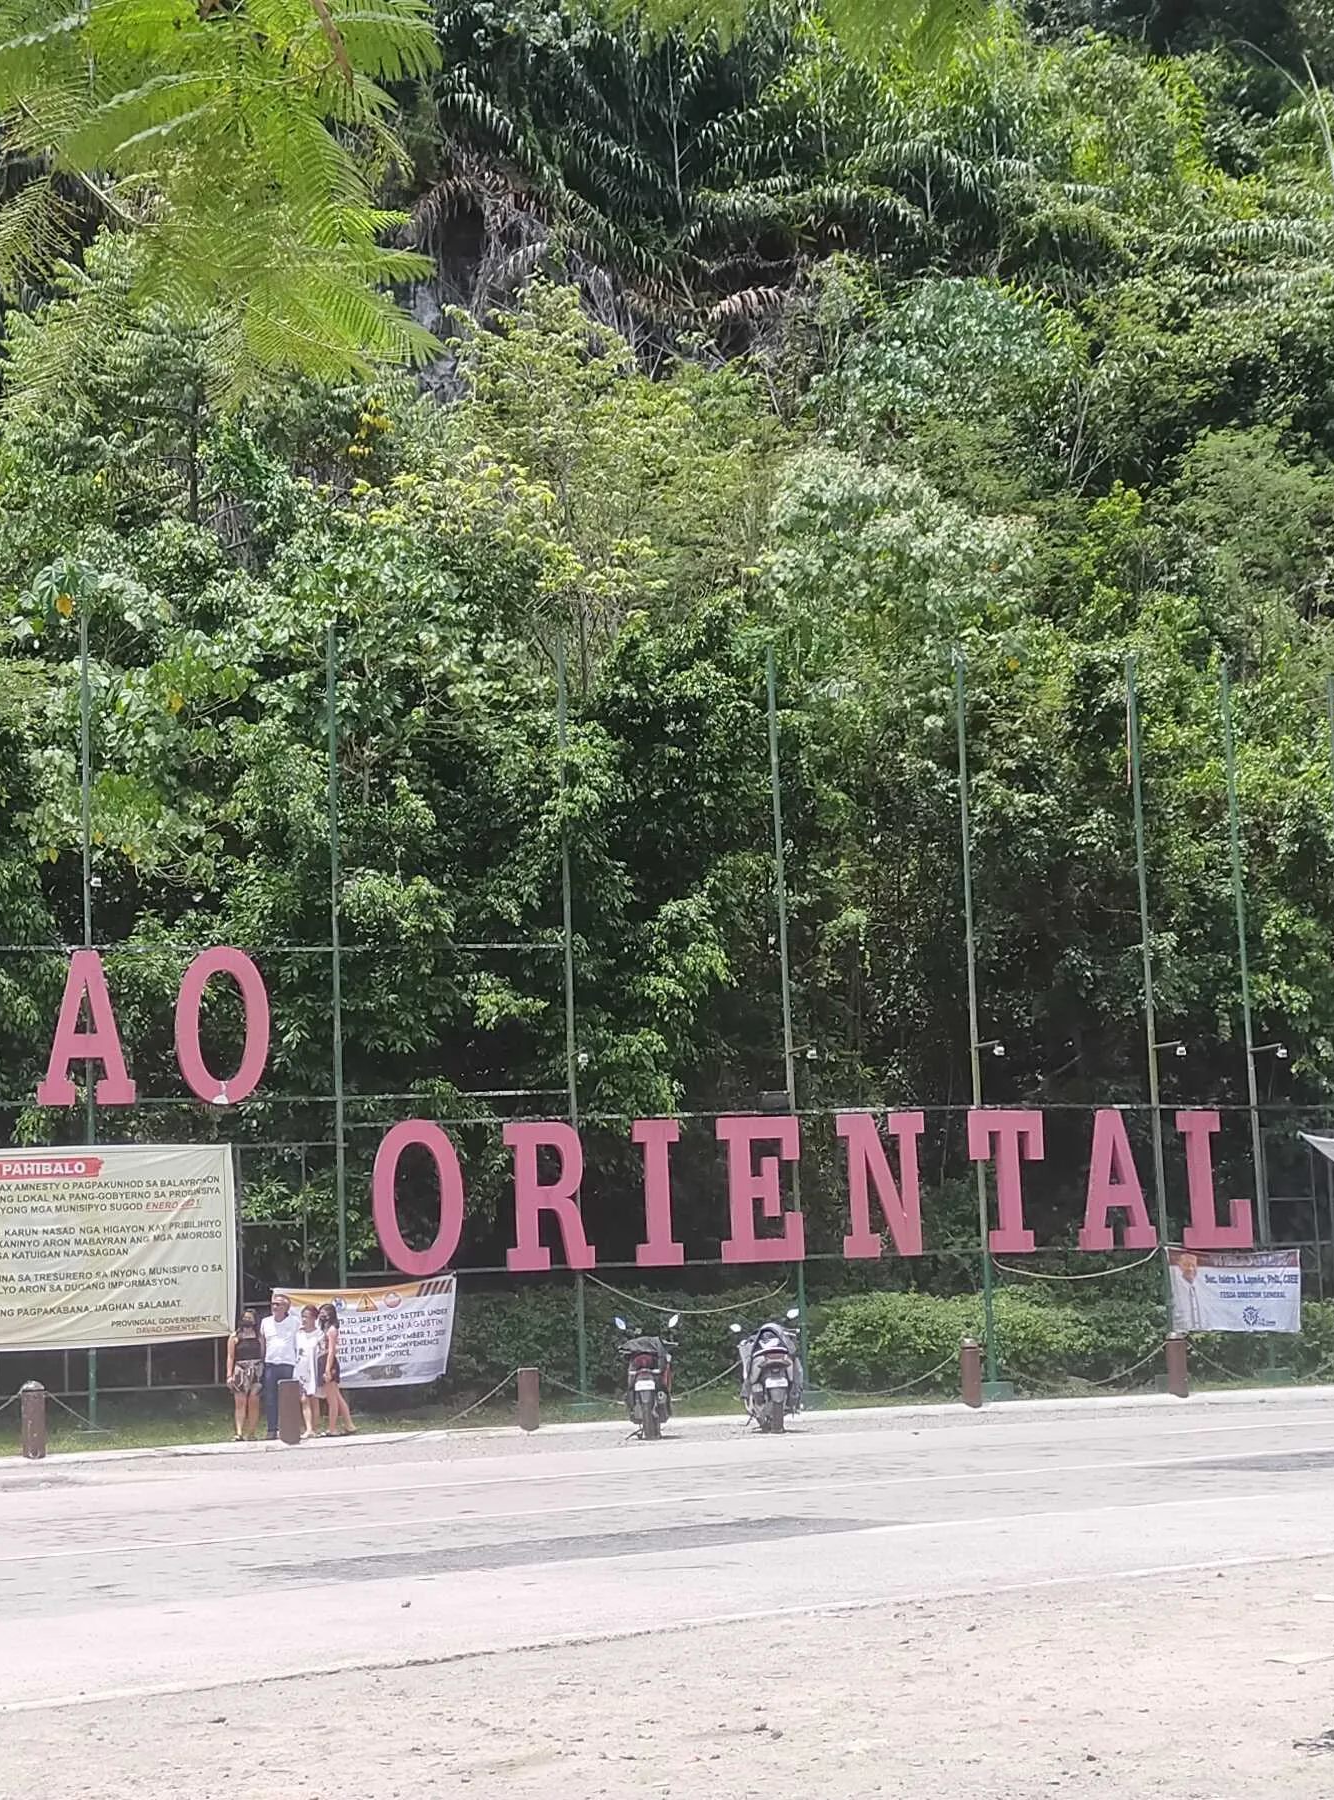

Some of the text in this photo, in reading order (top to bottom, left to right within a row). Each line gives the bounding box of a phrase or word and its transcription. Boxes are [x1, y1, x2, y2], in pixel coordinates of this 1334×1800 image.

[1, 1162, 86, 1176] PAHIBALO
[14, 1182, 60, 1192] AMNESTY
[62, 1181, 70, 1190] O
[72, 1180, 143, 1190] PAGPAKUNHOD
[146, 1179, 158, 1188] SA
[17, 1193, 49, 1203] LOKAL
[53, 1193, 66, 1201] NA
[69, 1190, 151, 1201] PANG-GOBYERNO
[154, 1190, 166, 1199] SA
[371, 1109, 1255, 1277] ORIENTAL
[30, 1205, 52, 1213] MGA
[55, 1203, 107, 1213] MUNISIPYO
[110, 1202, 143, 1211] SUGOD
[145, 1200, 178, 1210] ENERO
[4, 1227, 38, 1237] KARUN
[42, 1226, 75, 1235] NASAD
[79, 1226, 100, 1235] NGA
[103, 1225, 145, 1234] HIGAYON
[148, 1223, 165, 1232] KAY
[43, 1239, 70, 1247] ARON
[74, 1237, 127, 1246] MABAYRAN
[130, 1235, 149, 1244] ANG
[153, 1233, 173, 1242] MGA
[175, 1231, 222, 1240] AMOROSO
[12, 1250, 61, 1260] KATUIGAN
[63, 1248, 128, 1258] NAPASAGDAN
[18, 1274, 31, 1282] SA
[34, 1271, 92, 1282] TRESURERO
[110, 1269, 146, 1278] INYONG
[149, 1265, 199, 1276] MUNISIPYO
[201, 1264, 209, 1272] O
[211, 1264, 223, 1272] SA
[19, 1284, 46, 1294] ARON
[49, 1284, 62, 1292] SA
[111, 1319, 157, 1327] PROVINCIAL
[159, 1315, 212, 1325] GOVERNMENT
[359, 1315, 381, 1323] SERVE
[383, 1313, 398, 1321] YOU
[360, 1324, 383, 1334] CAPE
[387, 1321, 405, 1331] SAN
[407, 1318, 443, 1329] AGUSTIN
[350, 1336, 384, 1345] STARTING
[351, 1345, 365, 1353] FOR
[368, 1344, 382, 1352] ANY
